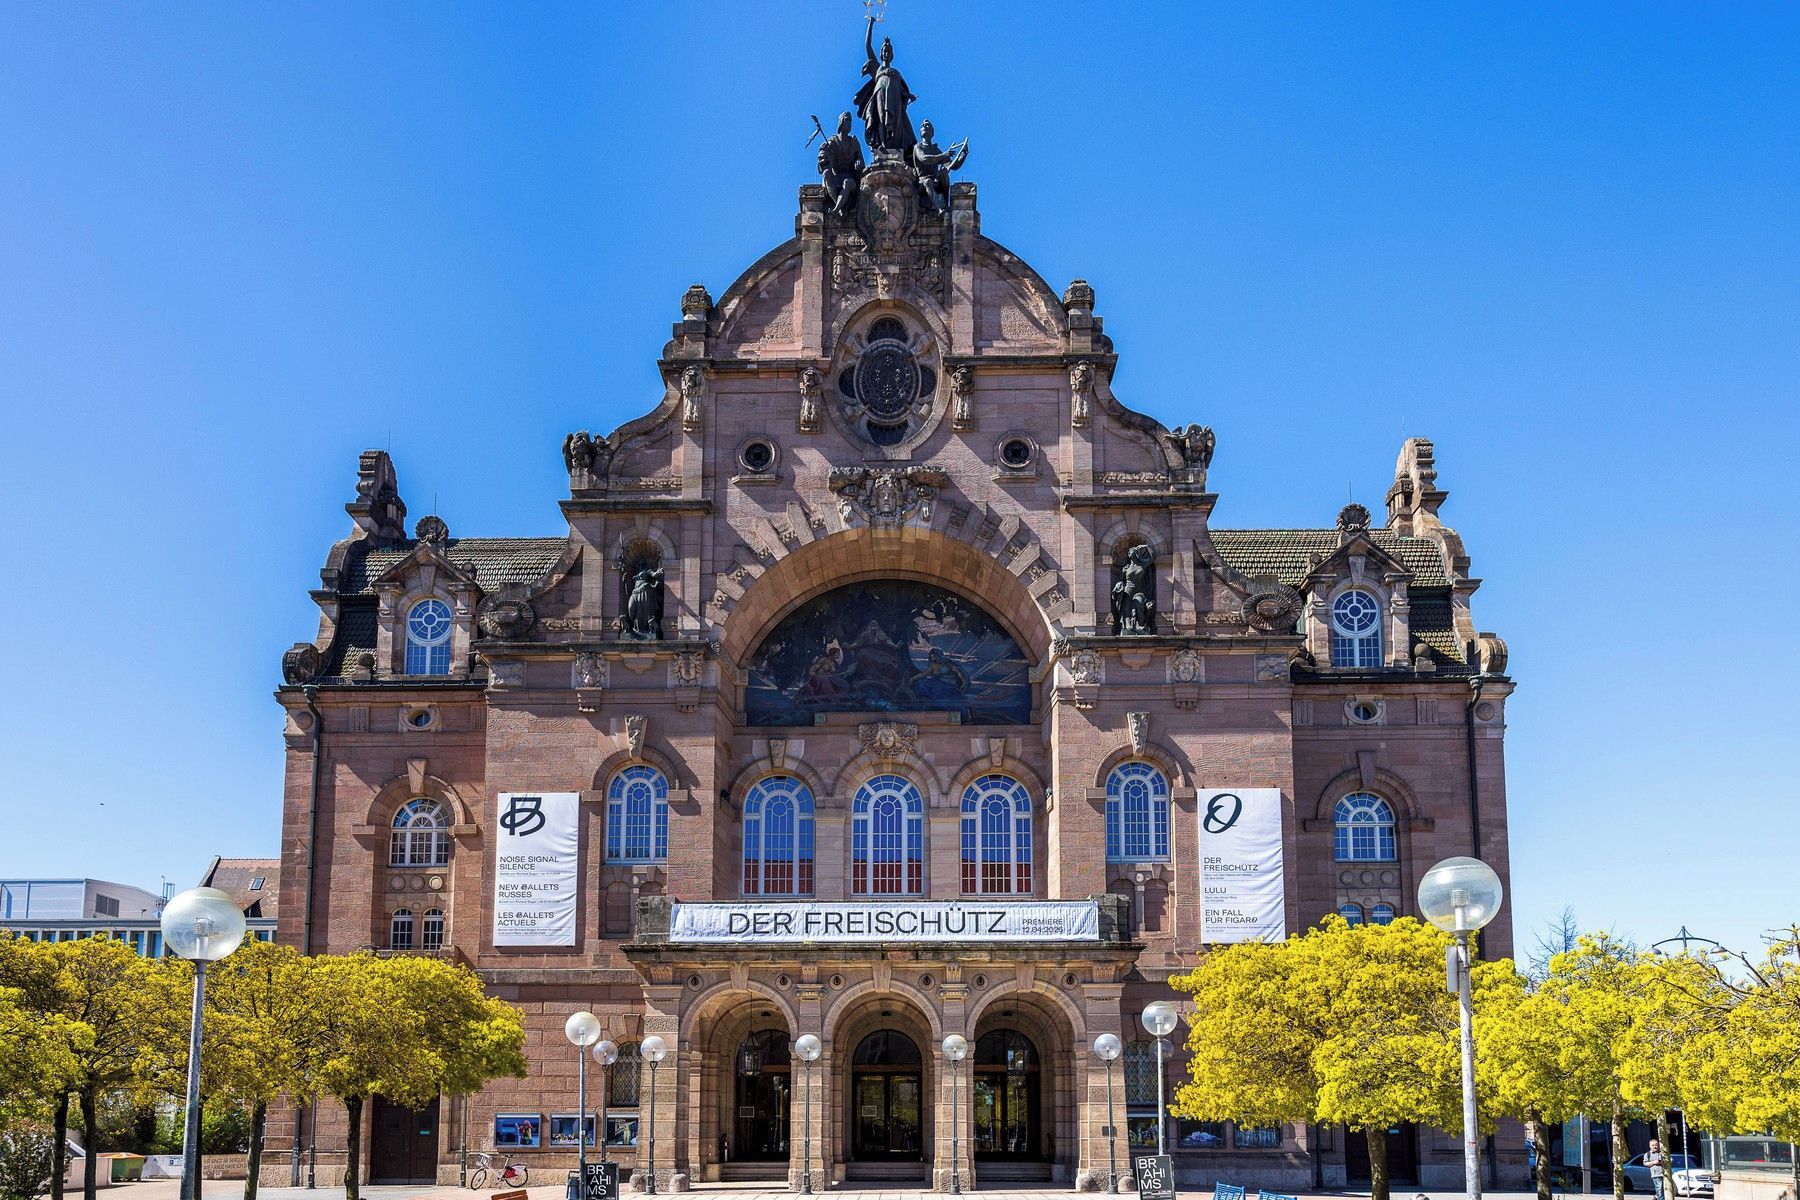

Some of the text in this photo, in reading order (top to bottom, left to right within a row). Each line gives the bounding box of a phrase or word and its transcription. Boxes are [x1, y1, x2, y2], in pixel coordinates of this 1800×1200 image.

[729, 907, 1007, 934] DER FREISCHÜTZ
[1139, 1158, 1157, 1168] BR
[587, 1164, 604, 1174] BR
[1140, 1178, 1161, 1189] MS
[586, 1185, 606, 1195] MS
